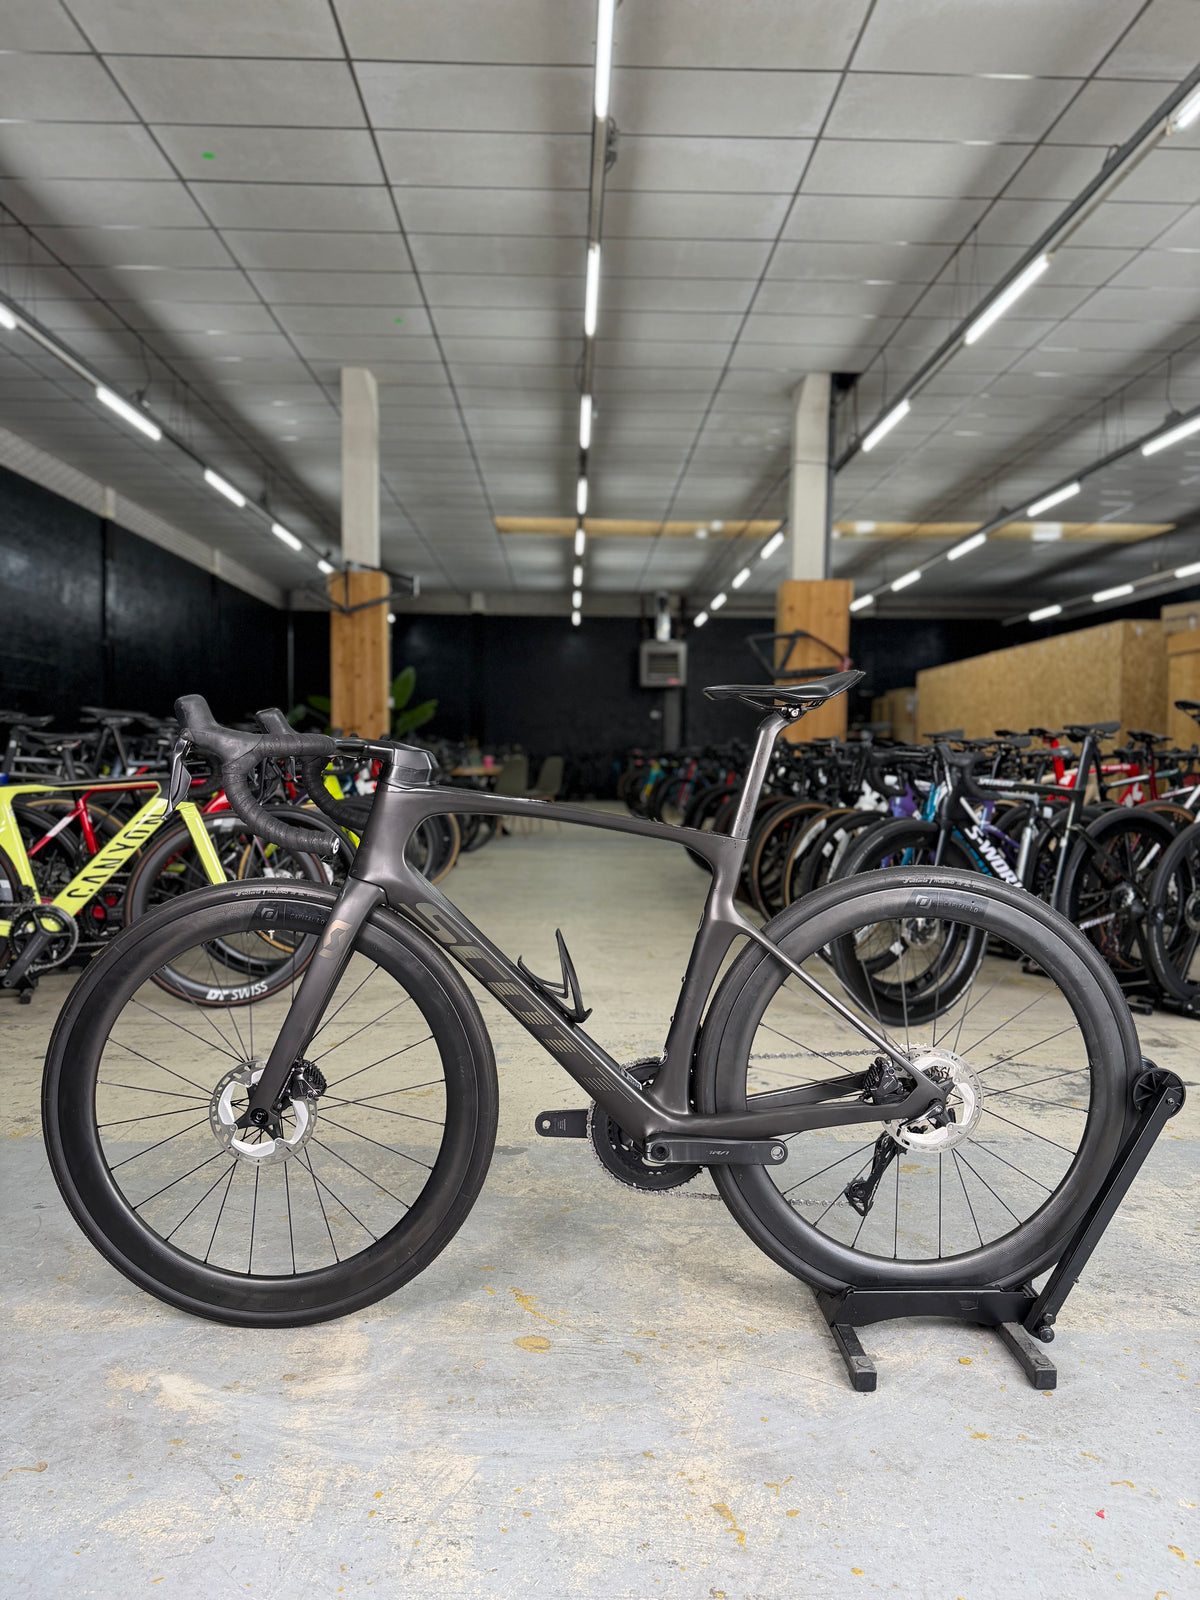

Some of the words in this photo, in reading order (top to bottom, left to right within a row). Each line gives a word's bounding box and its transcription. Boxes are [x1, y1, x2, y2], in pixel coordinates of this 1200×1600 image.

[66, 814, 162, 898] CANYON
[964, 824, 1027, 893] S-WOR
[205, 988, 230, 1002] DT
[230, 980, 269, 1001] SWISS
